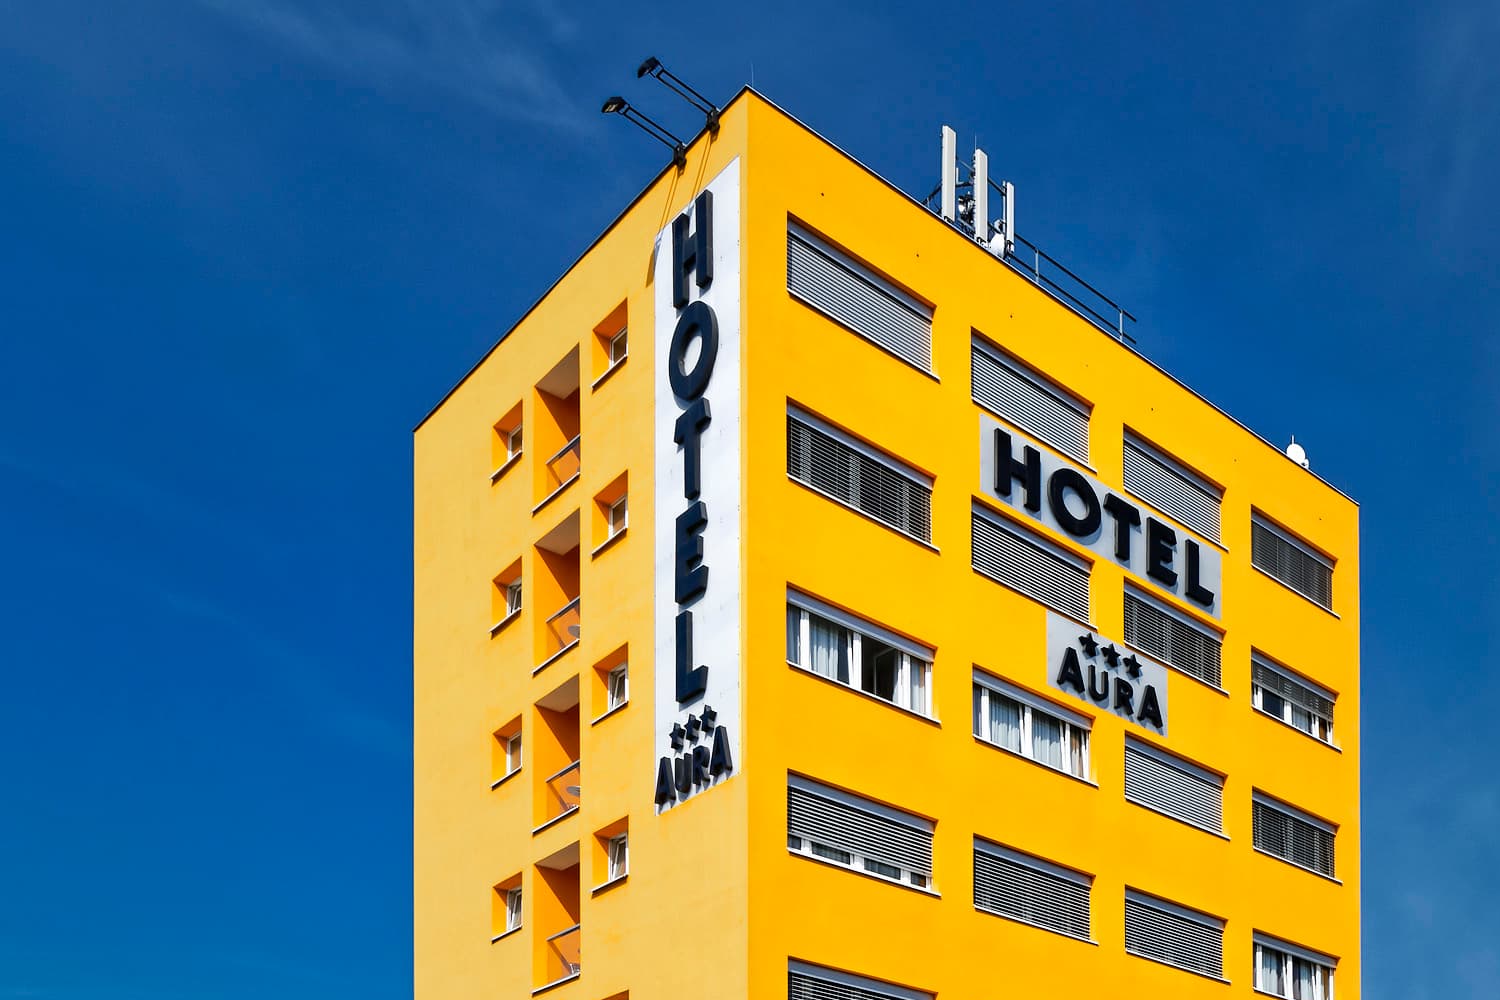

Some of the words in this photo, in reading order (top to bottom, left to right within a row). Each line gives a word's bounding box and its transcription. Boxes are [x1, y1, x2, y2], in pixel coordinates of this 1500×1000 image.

[668, 188, 719, 704] HOTEL
[994, 427, 1215, 606] HOTEL
[1056, 646, 1163, 729] AURA
[654, 724, 733, 806] AURA
